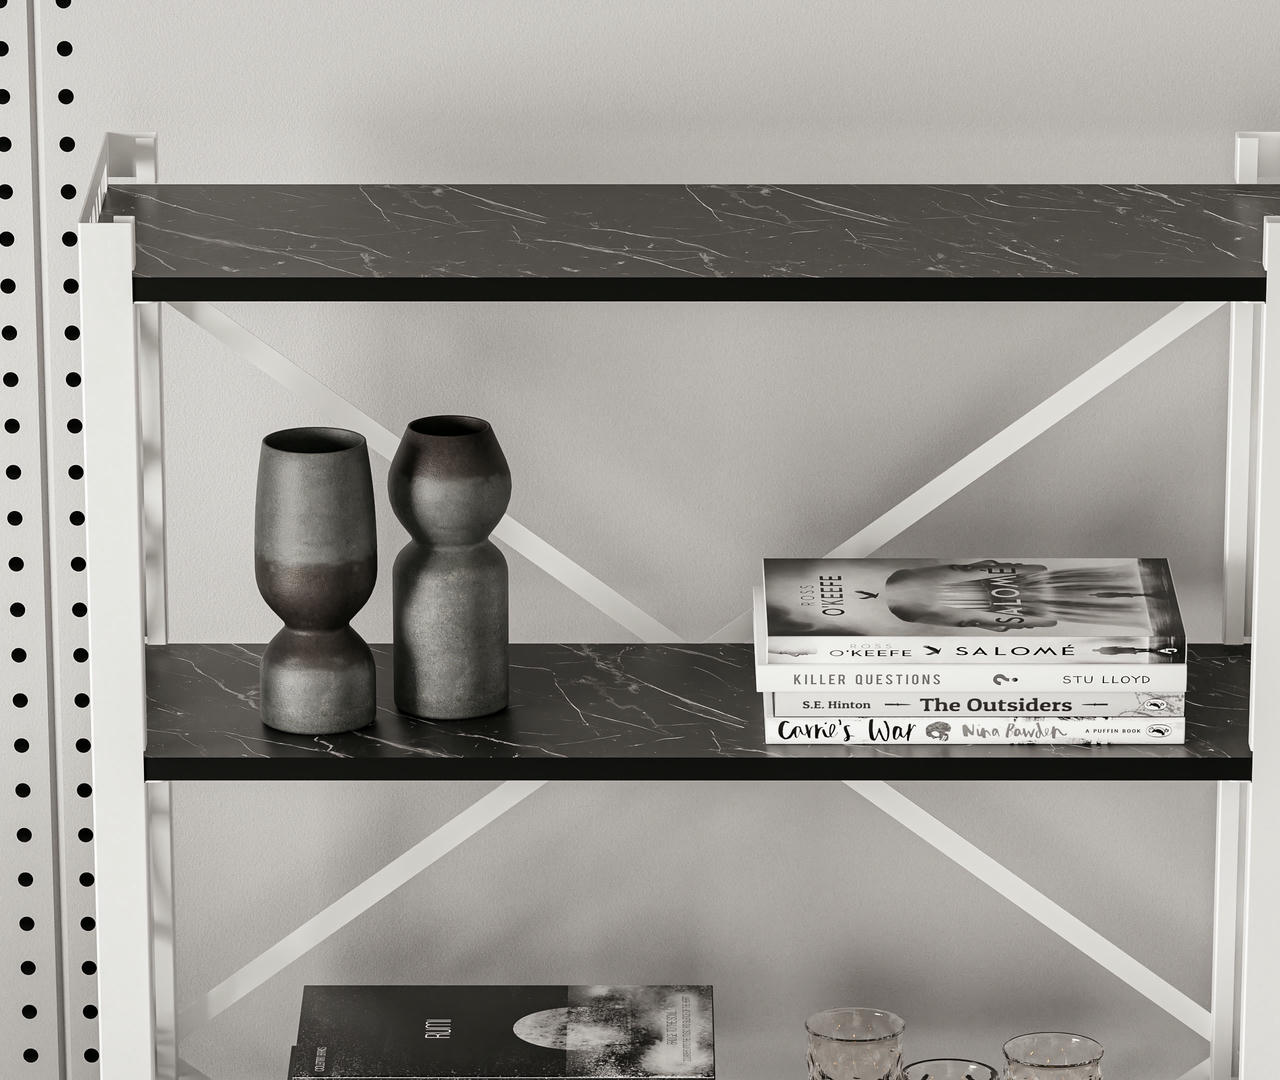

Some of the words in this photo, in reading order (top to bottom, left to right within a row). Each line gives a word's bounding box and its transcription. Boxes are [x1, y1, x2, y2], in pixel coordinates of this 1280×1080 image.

[819, 575, 845, 616] O'KEEFE
[979, 567, 1025, 624] SALOMÉ
[829, 649, 912, 657] O'KEEFE
[955, 644, 1075, 656] SALOMÉ
[793, 673, 846, 685] KILLER
[855, 673, 941, 686] QUESTIONS
[1062, 675, 1094, 684] STU
[1102, 675, 1151, 684] LLOYD
[802, 700, 825, 709] S.E.
[828, 700, 871, 709] Hinton
[919, 697, 961, 712] The
[966, 697, 1073, 712] Outsiders
[777, 719, 854, 743] Carrie's
[868, 718, 917, 742] War
[962, 723, 1000, 739] Nina
[1005, 722, 1068, 739] Bawden
